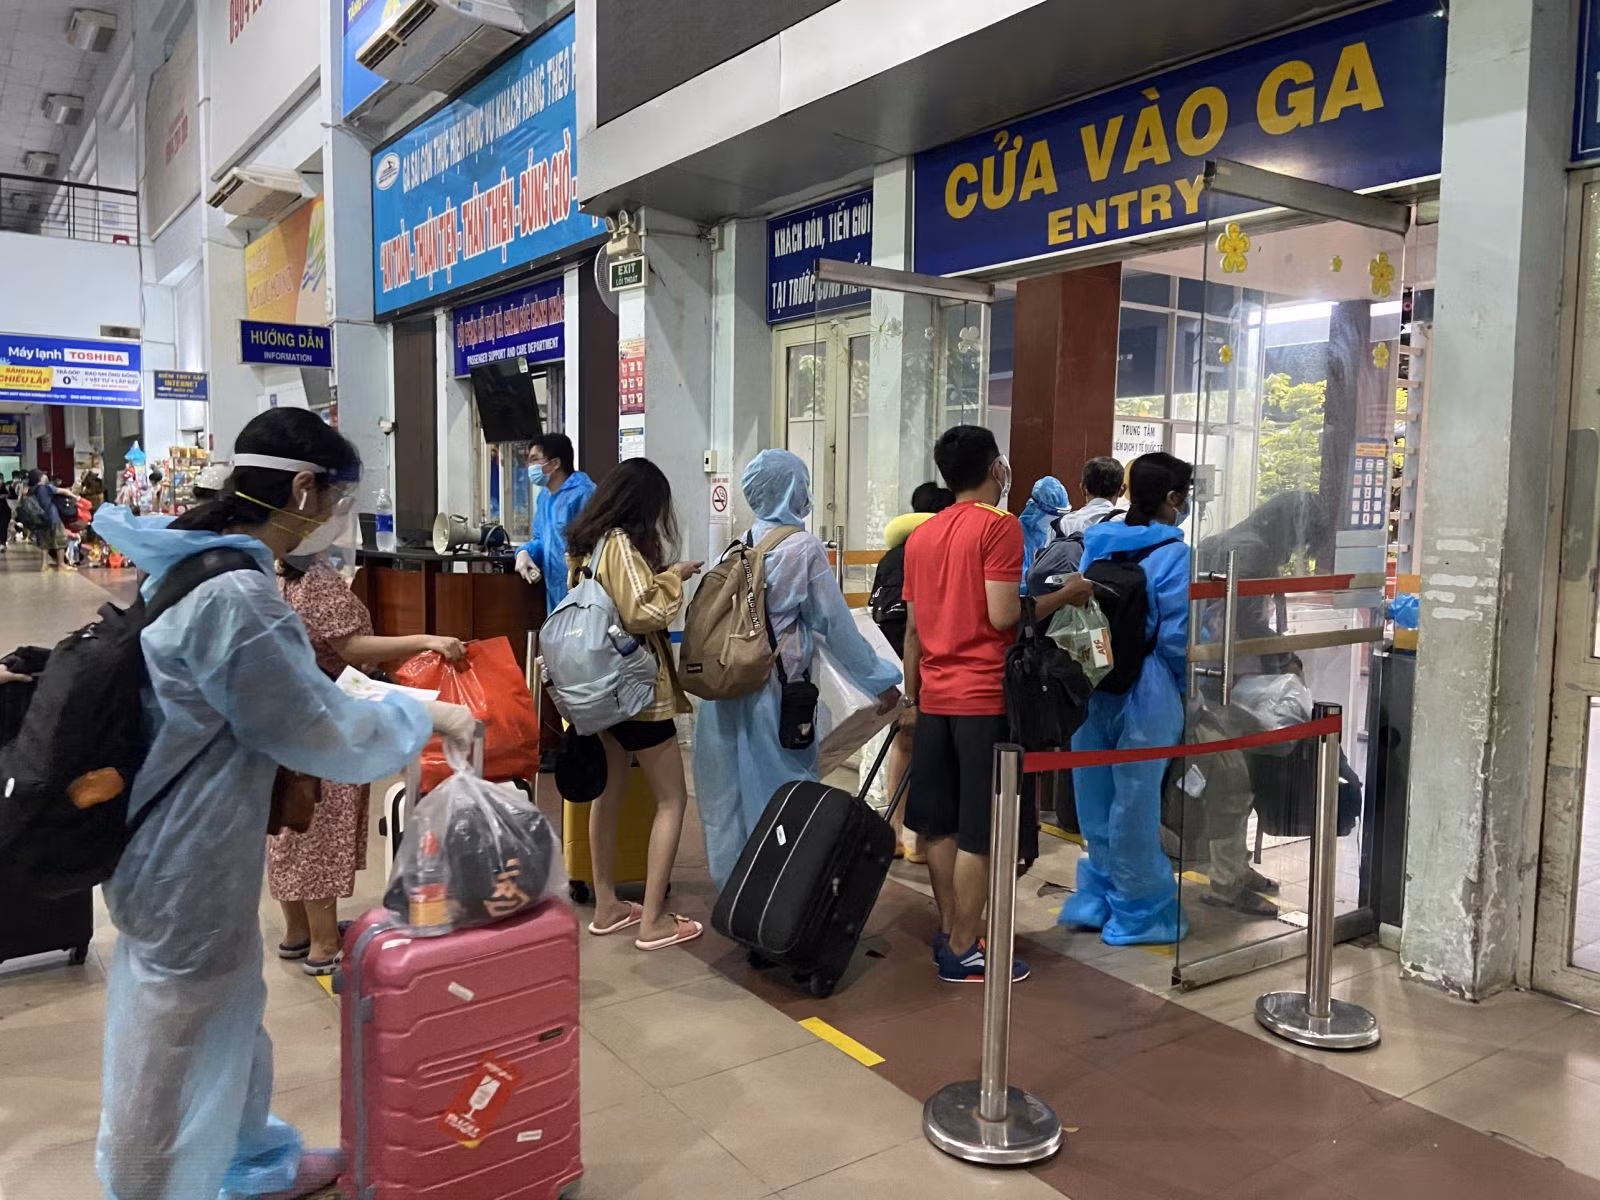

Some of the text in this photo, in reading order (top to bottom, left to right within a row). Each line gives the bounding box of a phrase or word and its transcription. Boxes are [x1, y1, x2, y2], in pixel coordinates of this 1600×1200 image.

[547, 46, 569, 107] THEO
[944, 41, 1385, 220] CỬA VÀO GA
[461, 181, 485, 261] THÂN
[485, 166, 514, 264] THIỆN
[519, 147, 549, 238] ĐÚNG
[1047, 174, 1205, 246] ENTRY
[774, 221, 803, 258] KHÁCH
[805, 211, 825, 250] ĐÓN,
[618, 263, 636, 276] EXIT
[772, 280, 787, 314] TẠI
[788, 268, 815, 306] TRƯỚC
[8, 346, 124, 363] Máy lạnh TOSHIBA
[251, 328, 324, 350] HƯỚNG DẪN
[264, 351, 313, 362] INFORMATION
[488, 348, 506, 362] SUPPORT
[507, 346, 516, 358] AND
[516, 344, 528, 356] CARE
[528, 336, 559, 353] DEPARTMENT
[1122, 423, 1156, 437] TRUNG TÂM
[747, 592, 761, 629] SUPREME
